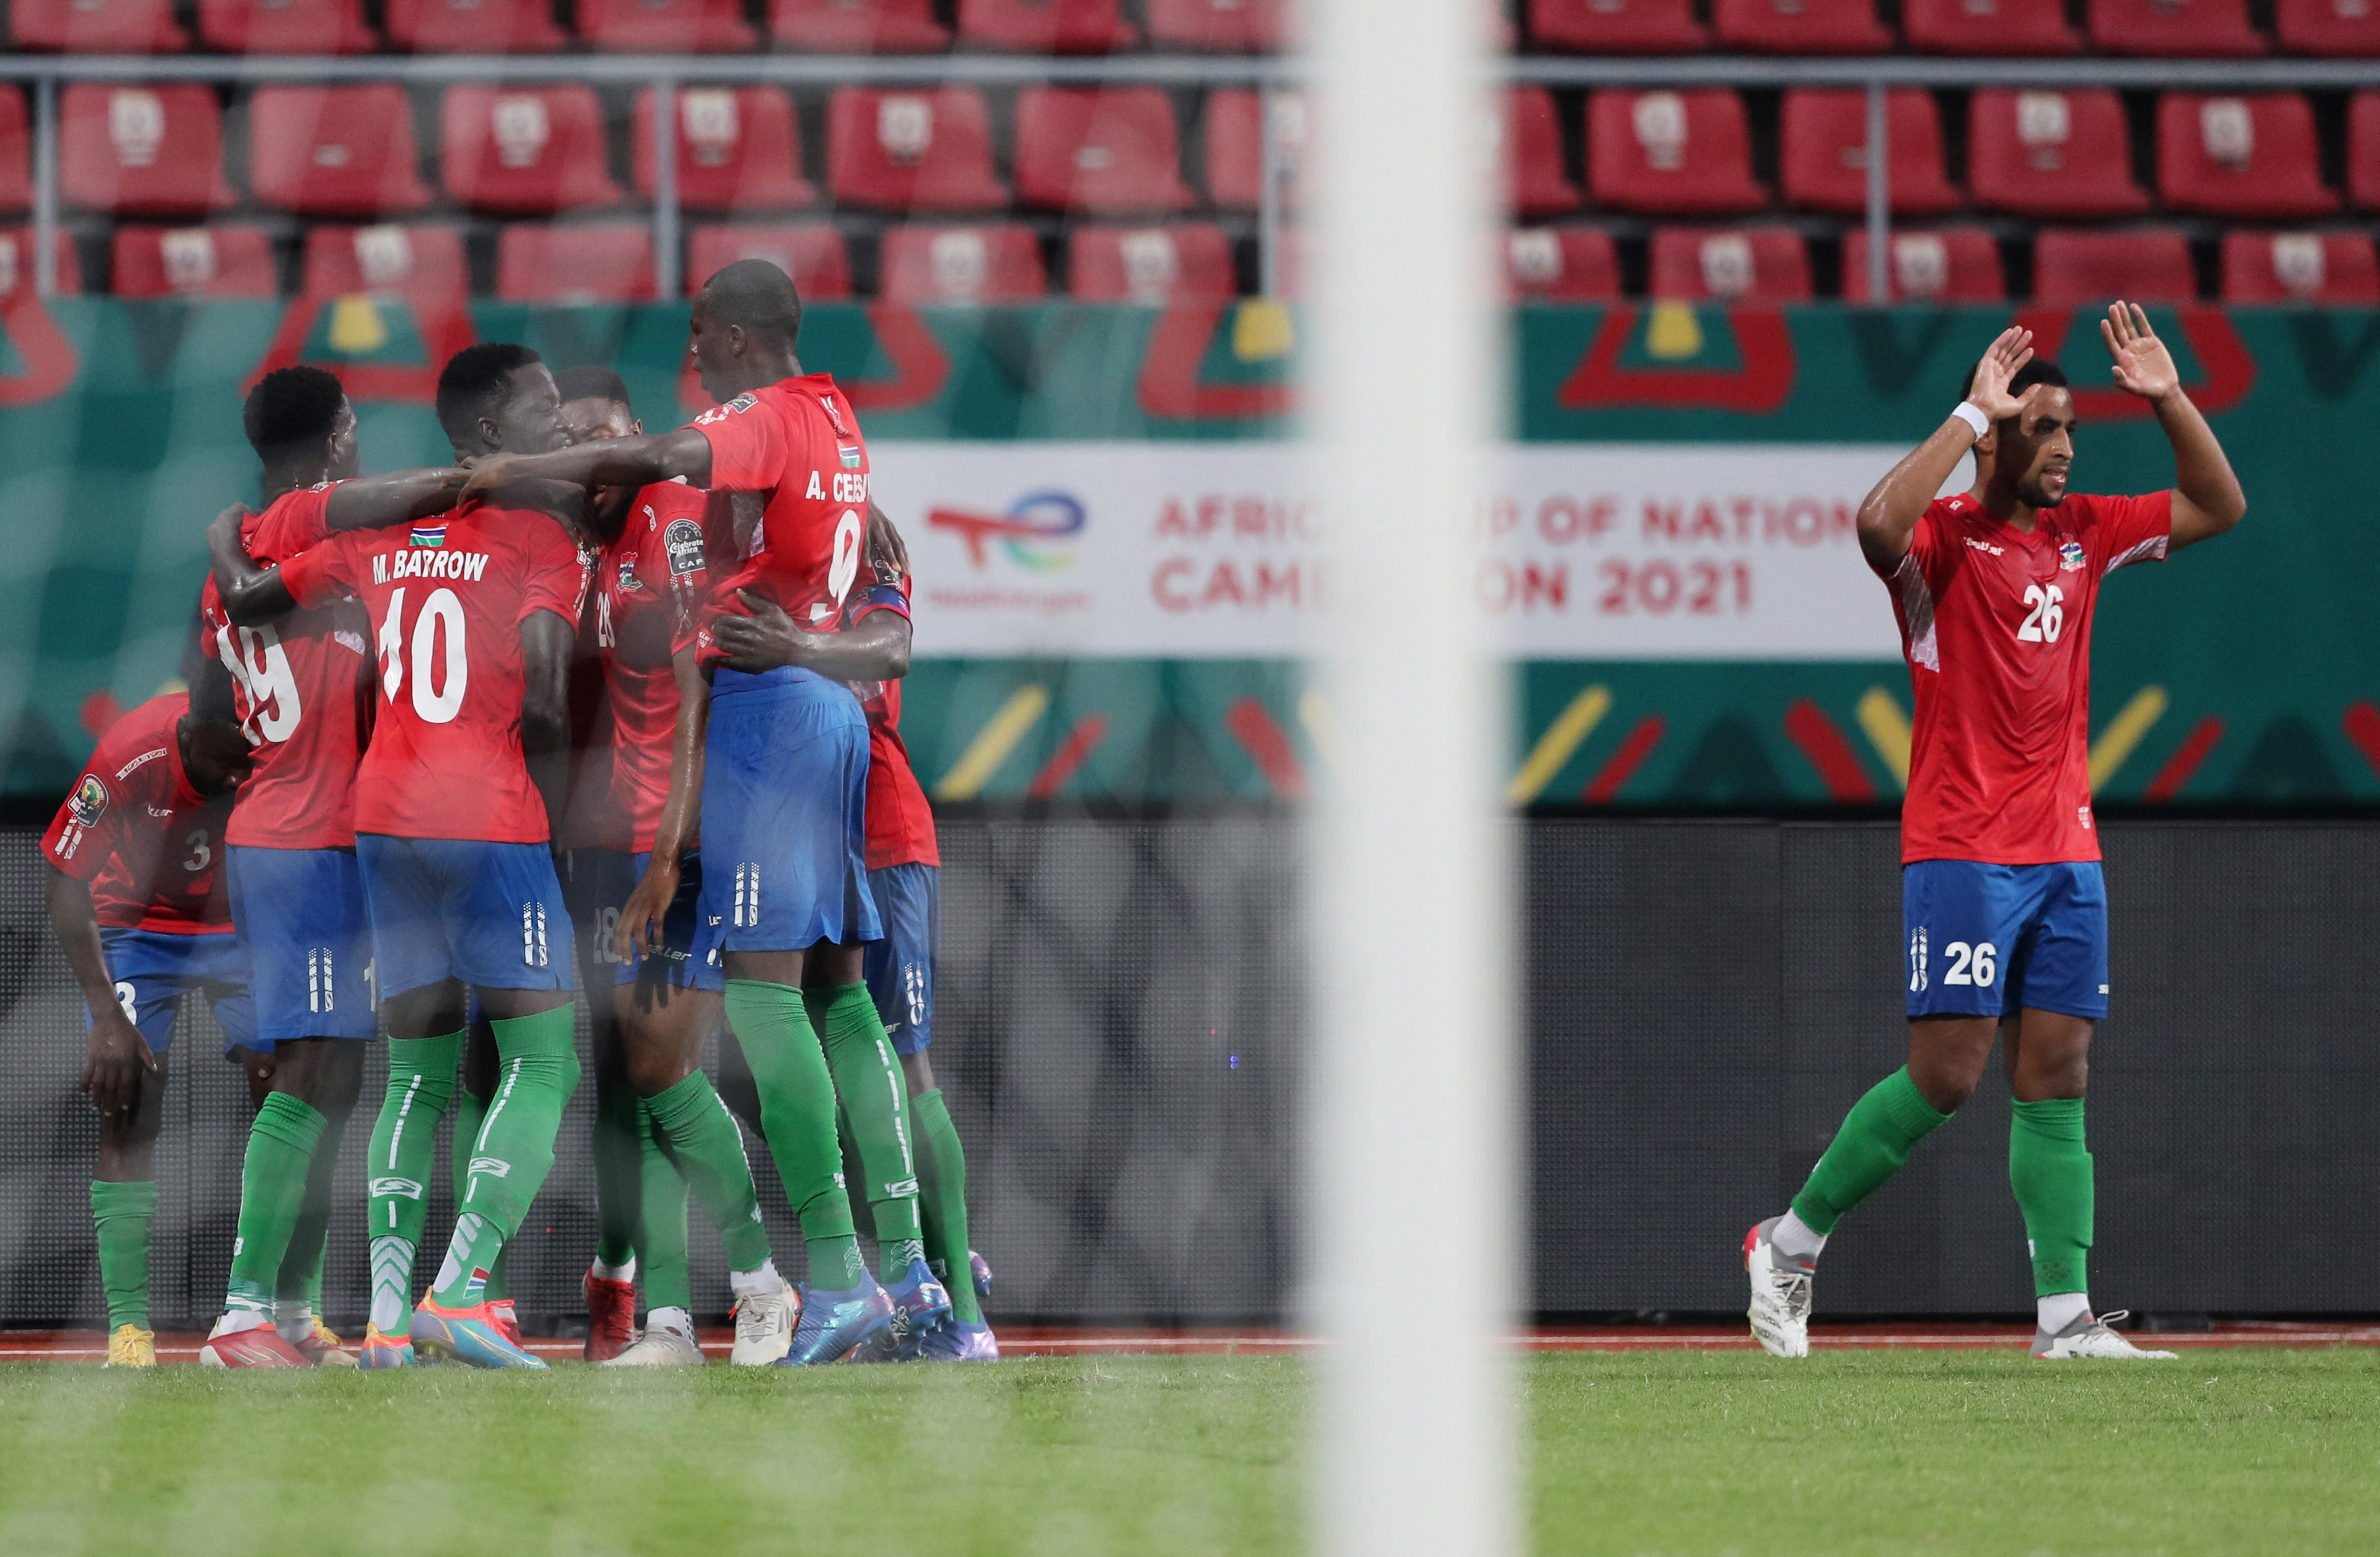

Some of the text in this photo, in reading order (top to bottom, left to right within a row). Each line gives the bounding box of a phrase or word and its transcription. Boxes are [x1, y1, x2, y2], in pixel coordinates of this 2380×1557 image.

[1537, 495, 1620, 546] OF
[1641, 495, 1856, 546] NATION
[678, 558, 703, 570] CAF
[1600, 558, 1753, 613] 2021
[597, 591, 616, 648] 28
[2017, 583, 2064, 643] 26
[378, 586, 467, 724] 10
[216, 621, 302, 746] 19
[183, 828, 211, 871] 3
[1943, 941, 1997, 988] 26
